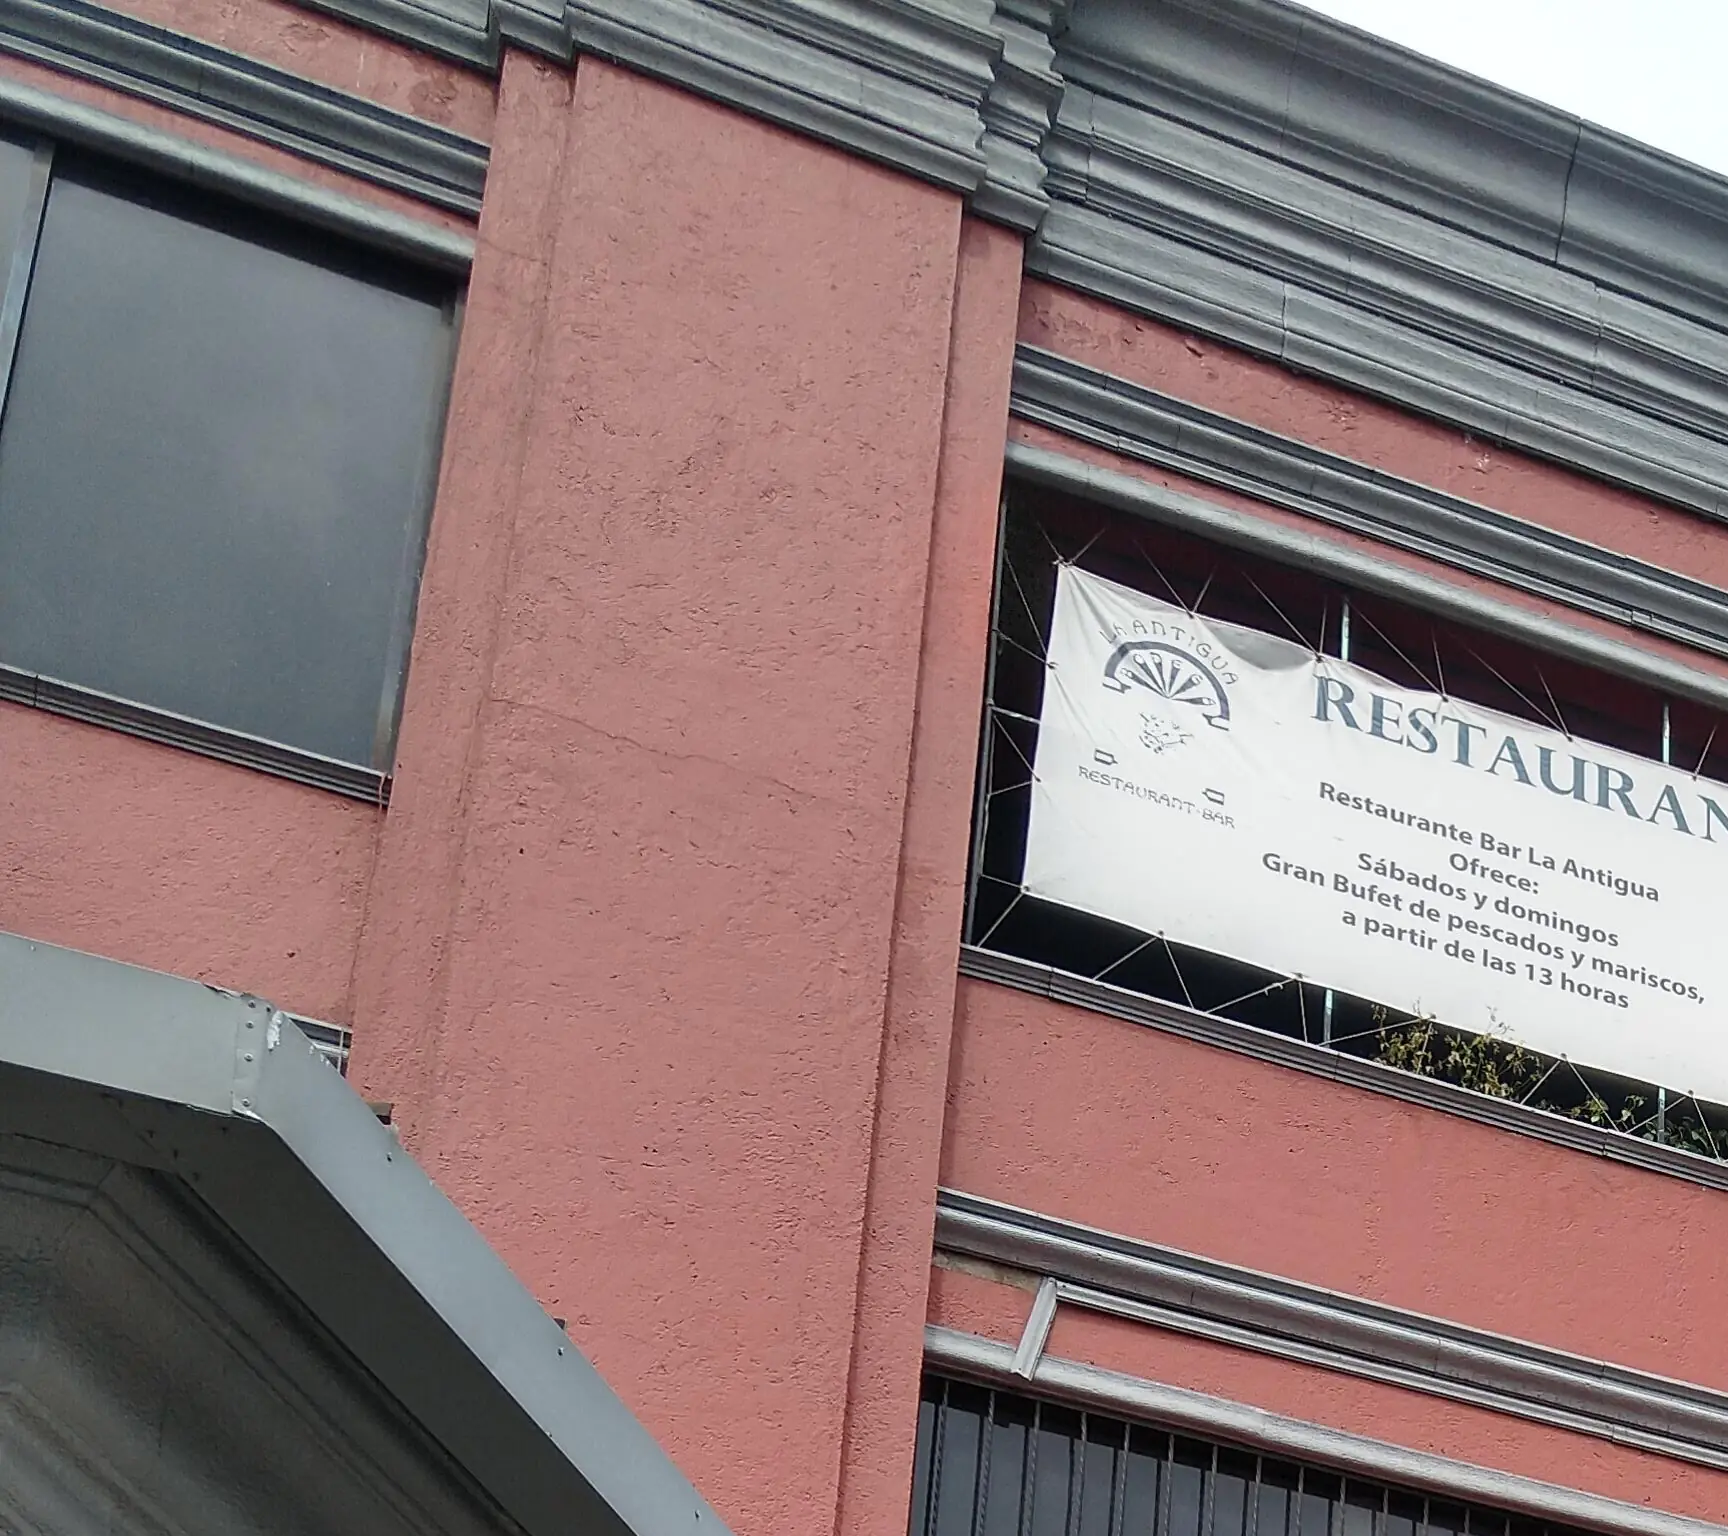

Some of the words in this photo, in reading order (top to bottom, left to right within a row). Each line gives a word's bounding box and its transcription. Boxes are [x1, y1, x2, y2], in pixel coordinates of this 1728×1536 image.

[1132, 619, 1239, 686] ANTIGUA
[1320, 782, 1472, 845] Restaurante
[1481, 832, 1521, 859] Bar
[1529, 847, 1555, 870] La
[1563, 859, 1658, 902] Antigua
[1450, 854, 1539, 895] Ofrece:
[1263, 853, 1324, 886] Gran
[1334, 873, 1402, 911] Bufet
[1409, 900, 1440, 922] de
[1447, 909, 1564, 960] pescados
[1571, 951, 1585, 969] y
[1592, 957, 1704, 1005] mariscos,
[1358, 853, 1468, 901] Sábados
[1474, 892, 1488, 910] y
[1495, 897, 1619, 947] domingos
[1342, 911, 1356, 926] a
[1365, 914, 1438, 951] partir
[1444, 940, 1475, 963] de
[1483, 949, 1516, 975] las
[1525, 964, 1552, 985] 13
[1561, 972, 1629, 1008] horas
